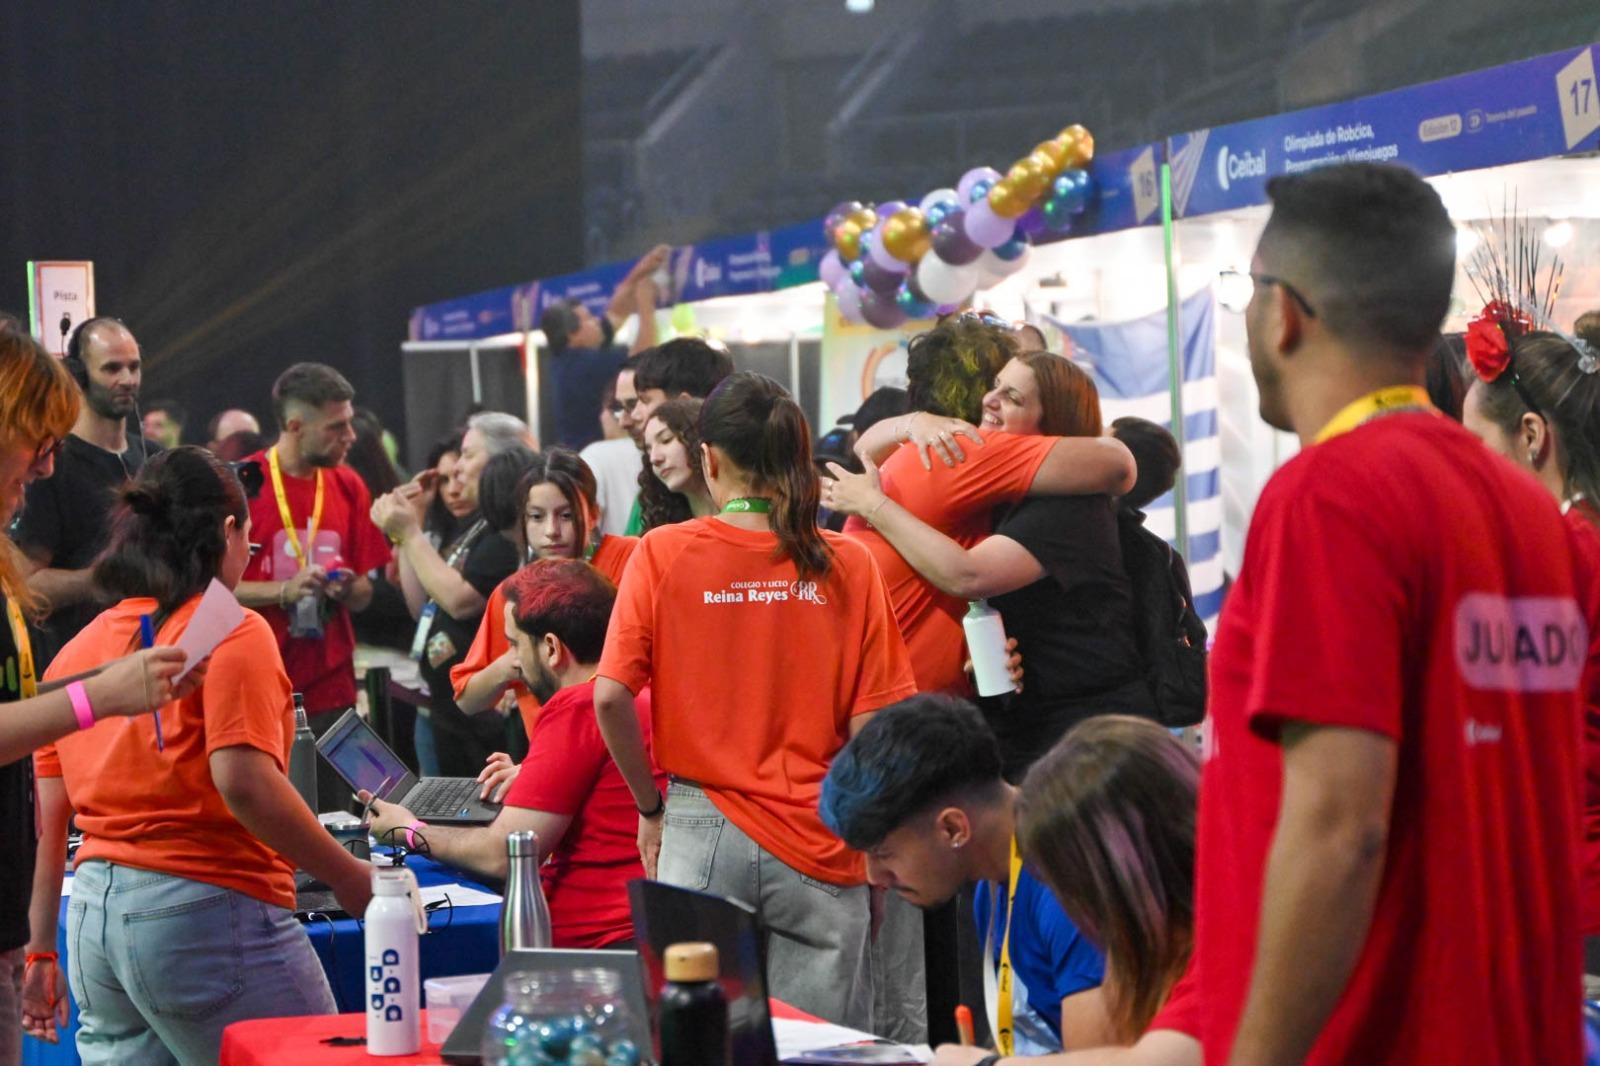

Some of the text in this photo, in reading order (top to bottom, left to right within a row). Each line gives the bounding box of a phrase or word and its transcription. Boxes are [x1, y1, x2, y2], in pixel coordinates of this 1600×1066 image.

[1570, 78, 1592, 116] 17
[1285, 130, 1324, 153] Olimpiada
[1325, 129, 1337, 146] de
[1228, 148, 1267, 180] Ceibal
[53, 290, 78, 301] Pista
[730, 581, 761, 589] COLEGIO
[768, 580, 789, 588] LICEO
[703, 588, 789, 605] Reina Reyes
